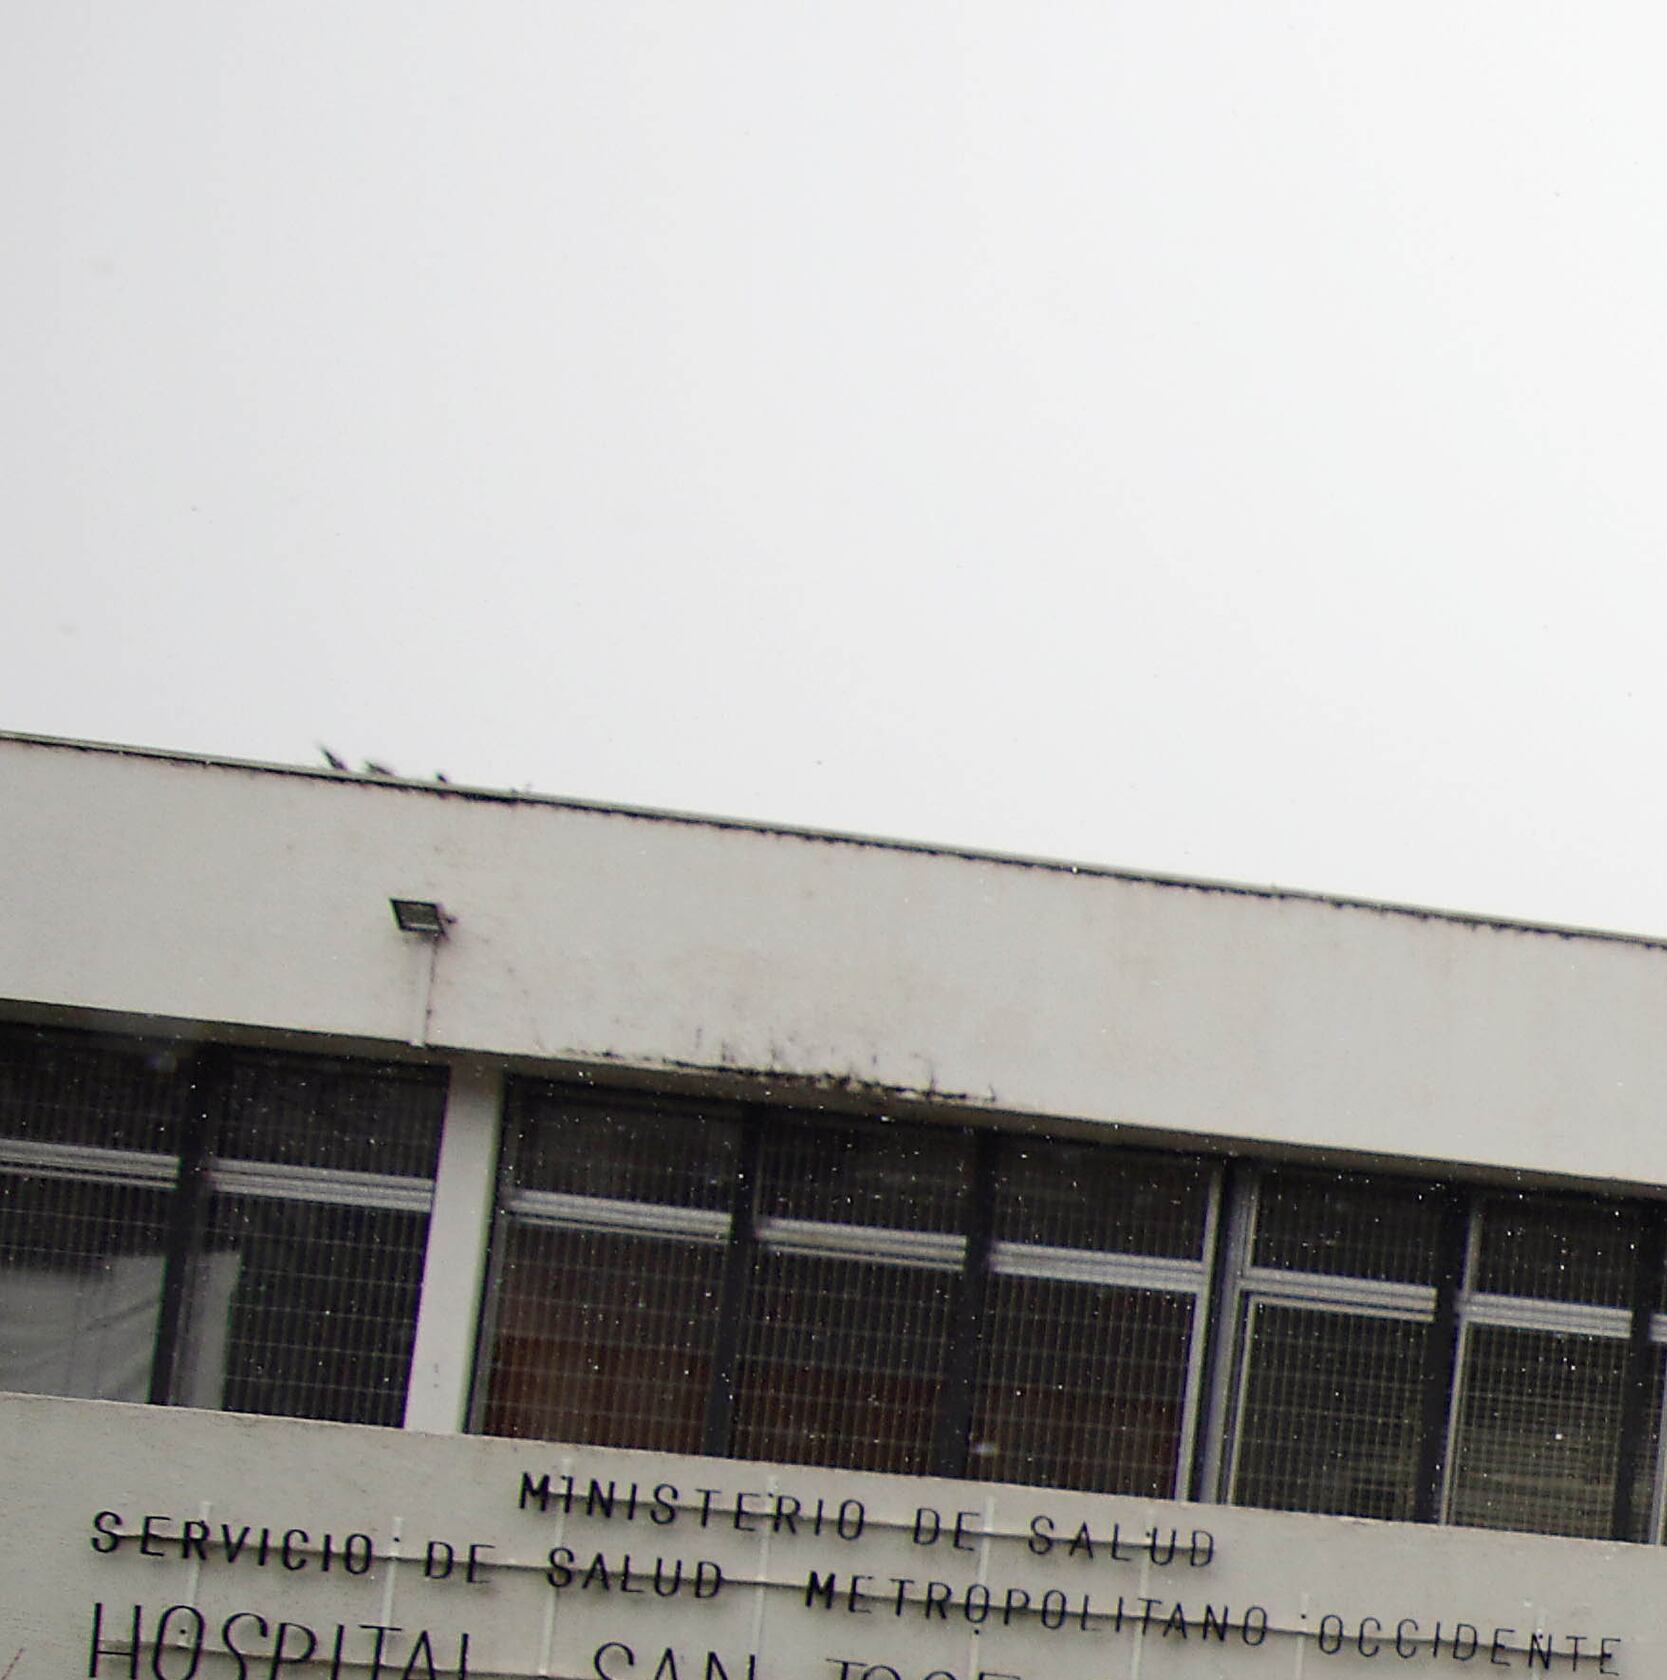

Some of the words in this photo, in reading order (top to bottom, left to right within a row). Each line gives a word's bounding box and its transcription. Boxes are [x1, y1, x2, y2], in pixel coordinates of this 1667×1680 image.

[519, 1471, 867, 1541] MINISTERIO
[913, 1507, 982, 1553] DE
[1027, 1514, 1216, 1568] SALUD
[91, 1510, 374, 1577] SERVICIO
[424, 1540, 498, 1587] DE
[546, 1546, 725, 1600] SALUD
[805, 1570, 1269, 1647] METROPOLITANO
[1317, 1612, 1623, 1676] OCCIDENTE
